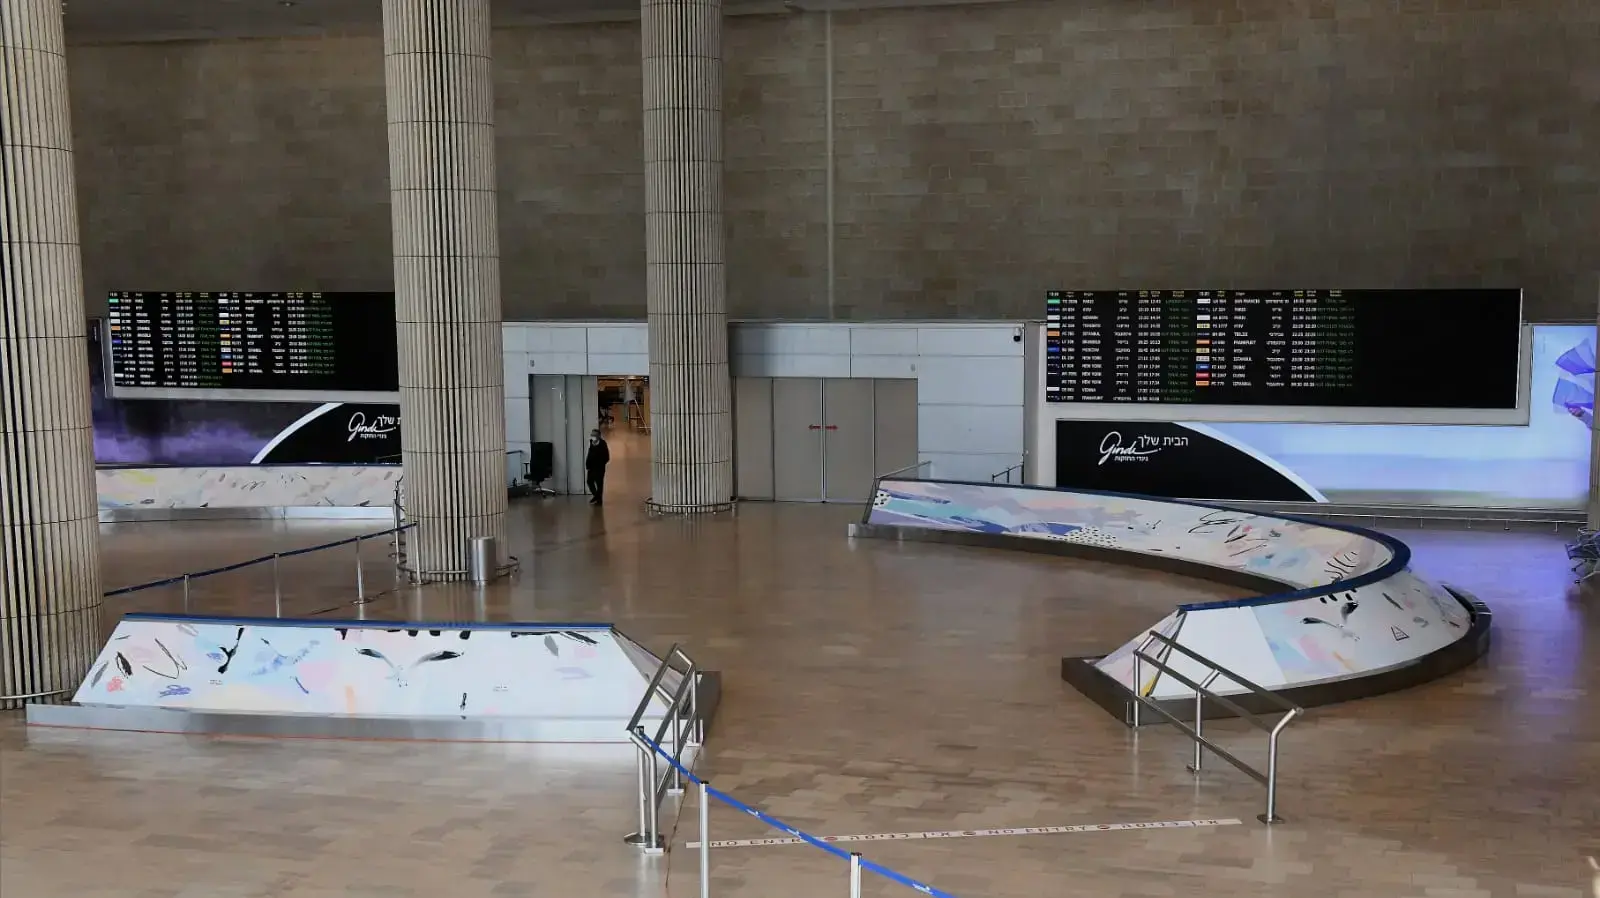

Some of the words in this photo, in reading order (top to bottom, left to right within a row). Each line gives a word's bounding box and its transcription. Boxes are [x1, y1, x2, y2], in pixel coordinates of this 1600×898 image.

[377, 414, 395, 427] שלך
[1137, 434, 1160, 448] שלך
[1163, 436, 1189, 446] הבית
[1025, 825, 1085, 833] ENTRY
